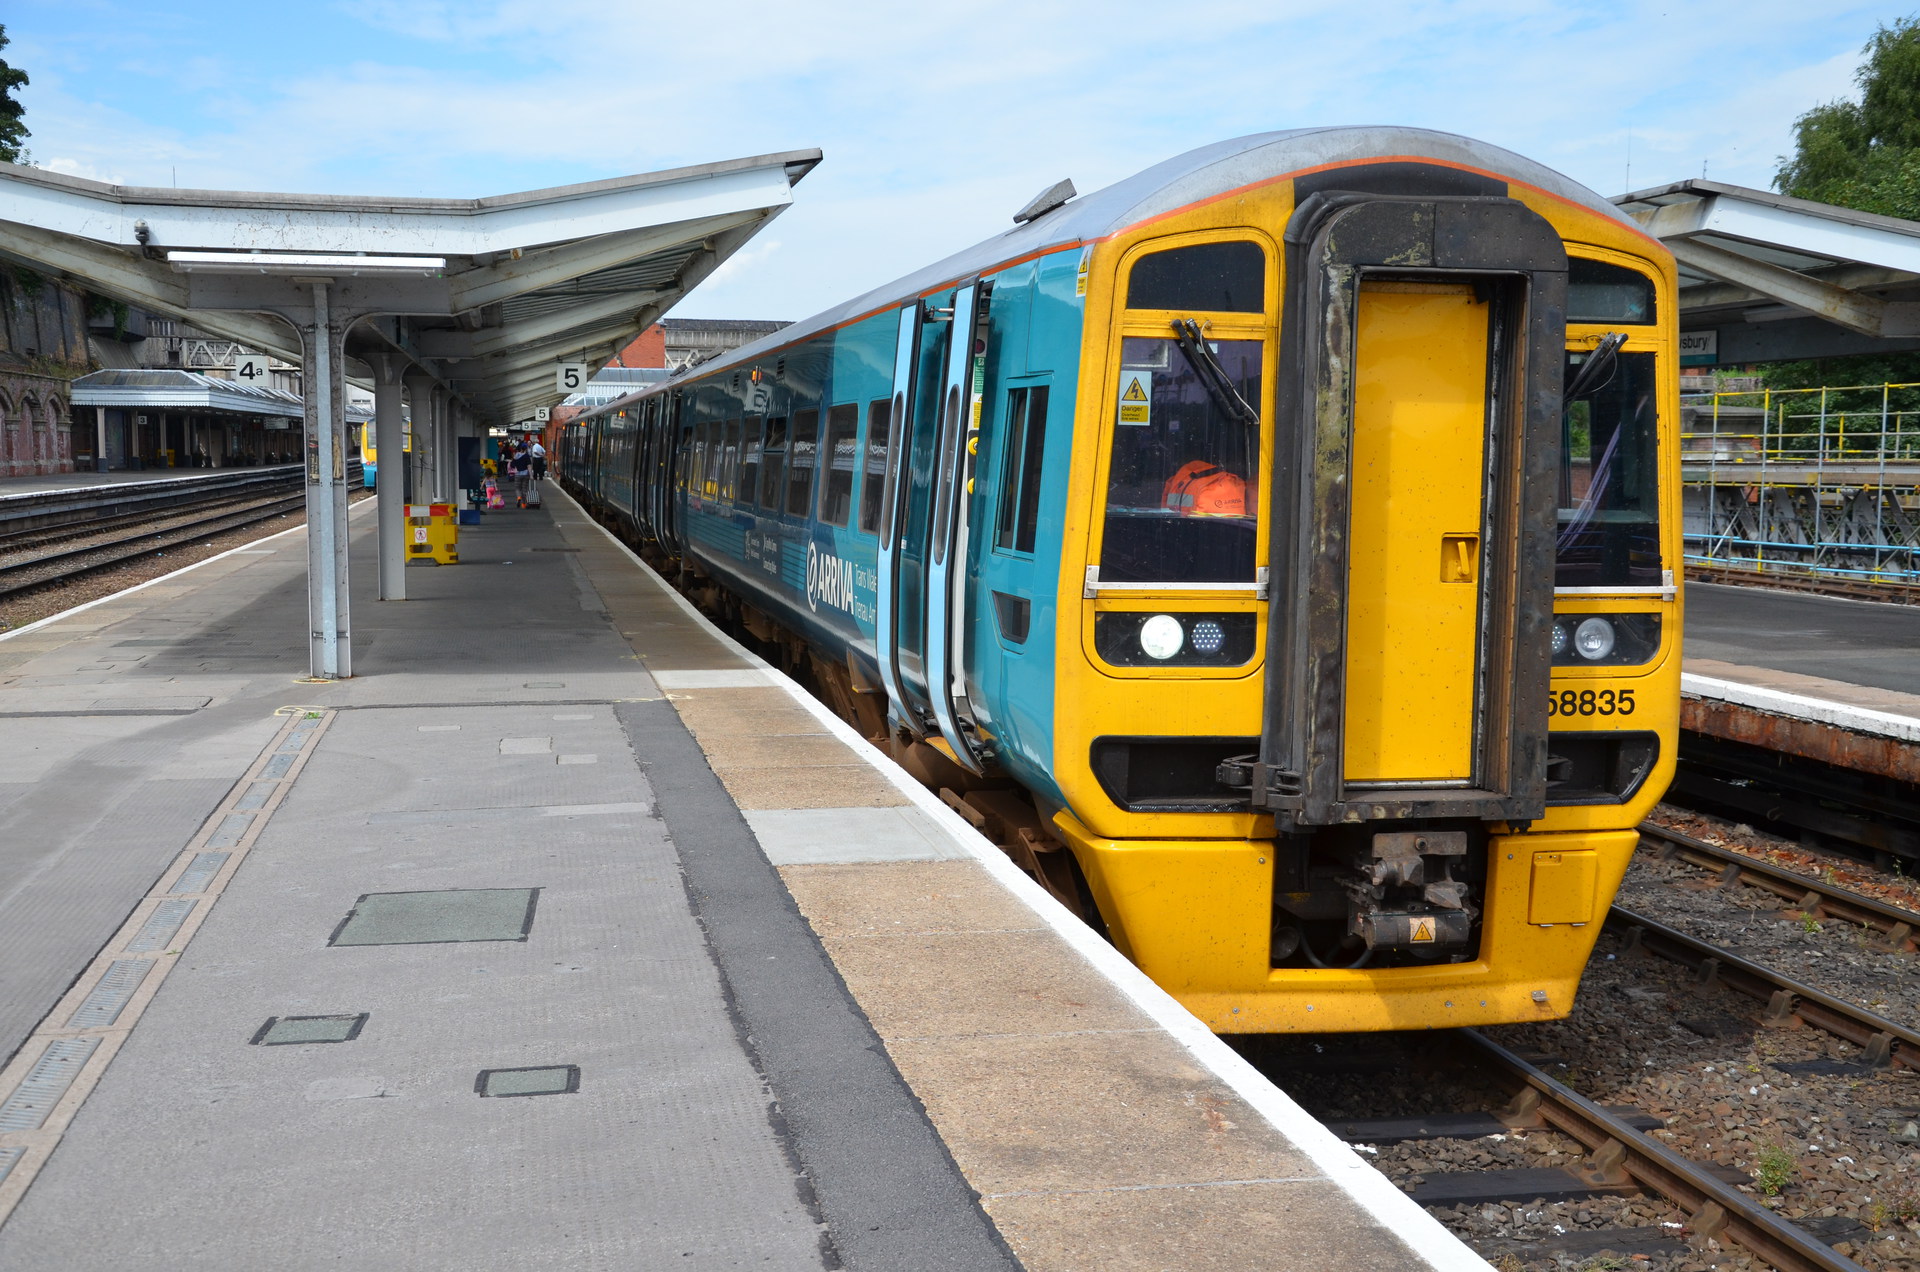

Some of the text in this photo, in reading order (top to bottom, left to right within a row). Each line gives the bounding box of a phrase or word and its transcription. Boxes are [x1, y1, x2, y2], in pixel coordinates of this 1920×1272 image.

[1680, 335, 1708, 351] sbury
[239, 361, 263, 380] 4a
[564, 368, 580, 389] 5
[539, 409, 546, 418] 5
[818, 553, 854, 615] ARRIVA
[855, 564, 867, 589] Trains
[854, 596, 868, 622] Trenau
